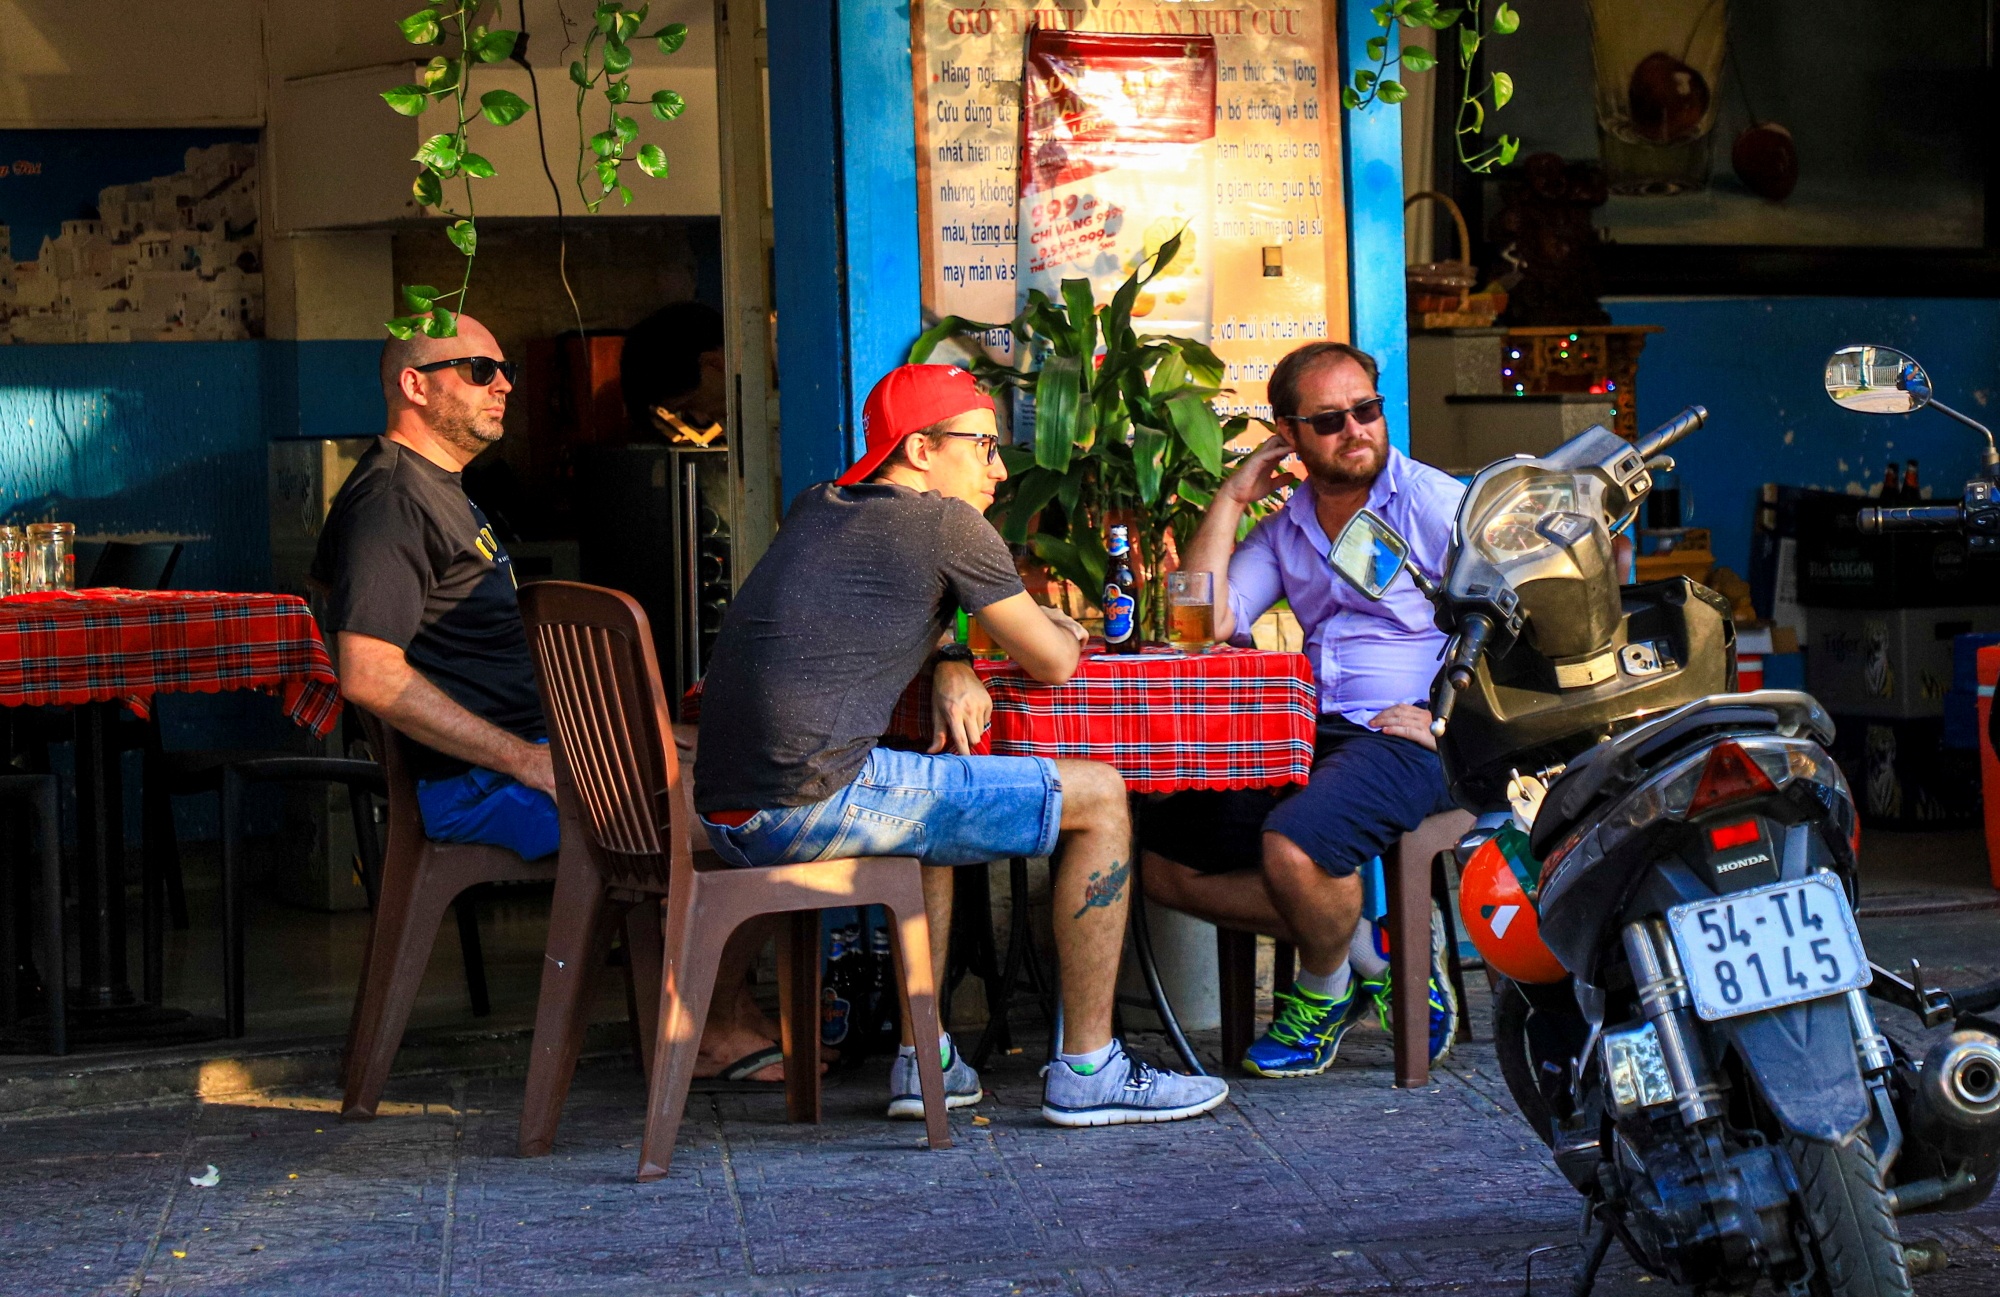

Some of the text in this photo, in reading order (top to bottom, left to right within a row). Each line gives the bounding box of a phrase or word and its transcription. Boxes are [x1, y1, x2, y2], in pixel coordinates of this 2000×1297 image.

[1188, 9, 1246, 41] THỊT
[942, 60, 970, 89] Hàng
[937, 100, 959, 122] Cừu
[965, 99, 992, 128] dùng
[939, 137, 963, 162] nhất
[1303, 142, 1320, 158] cao
[980, 176, 1014, 207] không
[942, 218, 968, 245] máu,
[971, 218, 1001, 248] tráng
[943, 264, 965, 288] may
[969, 256, 991, 281] mắn
[995, 258, 1008, 280] và
[1716, 853, 1770, 875] HONDA
[1697, 888, 1824, 953] 54-T4
[1714, 936, 1842, 1006] 8145
